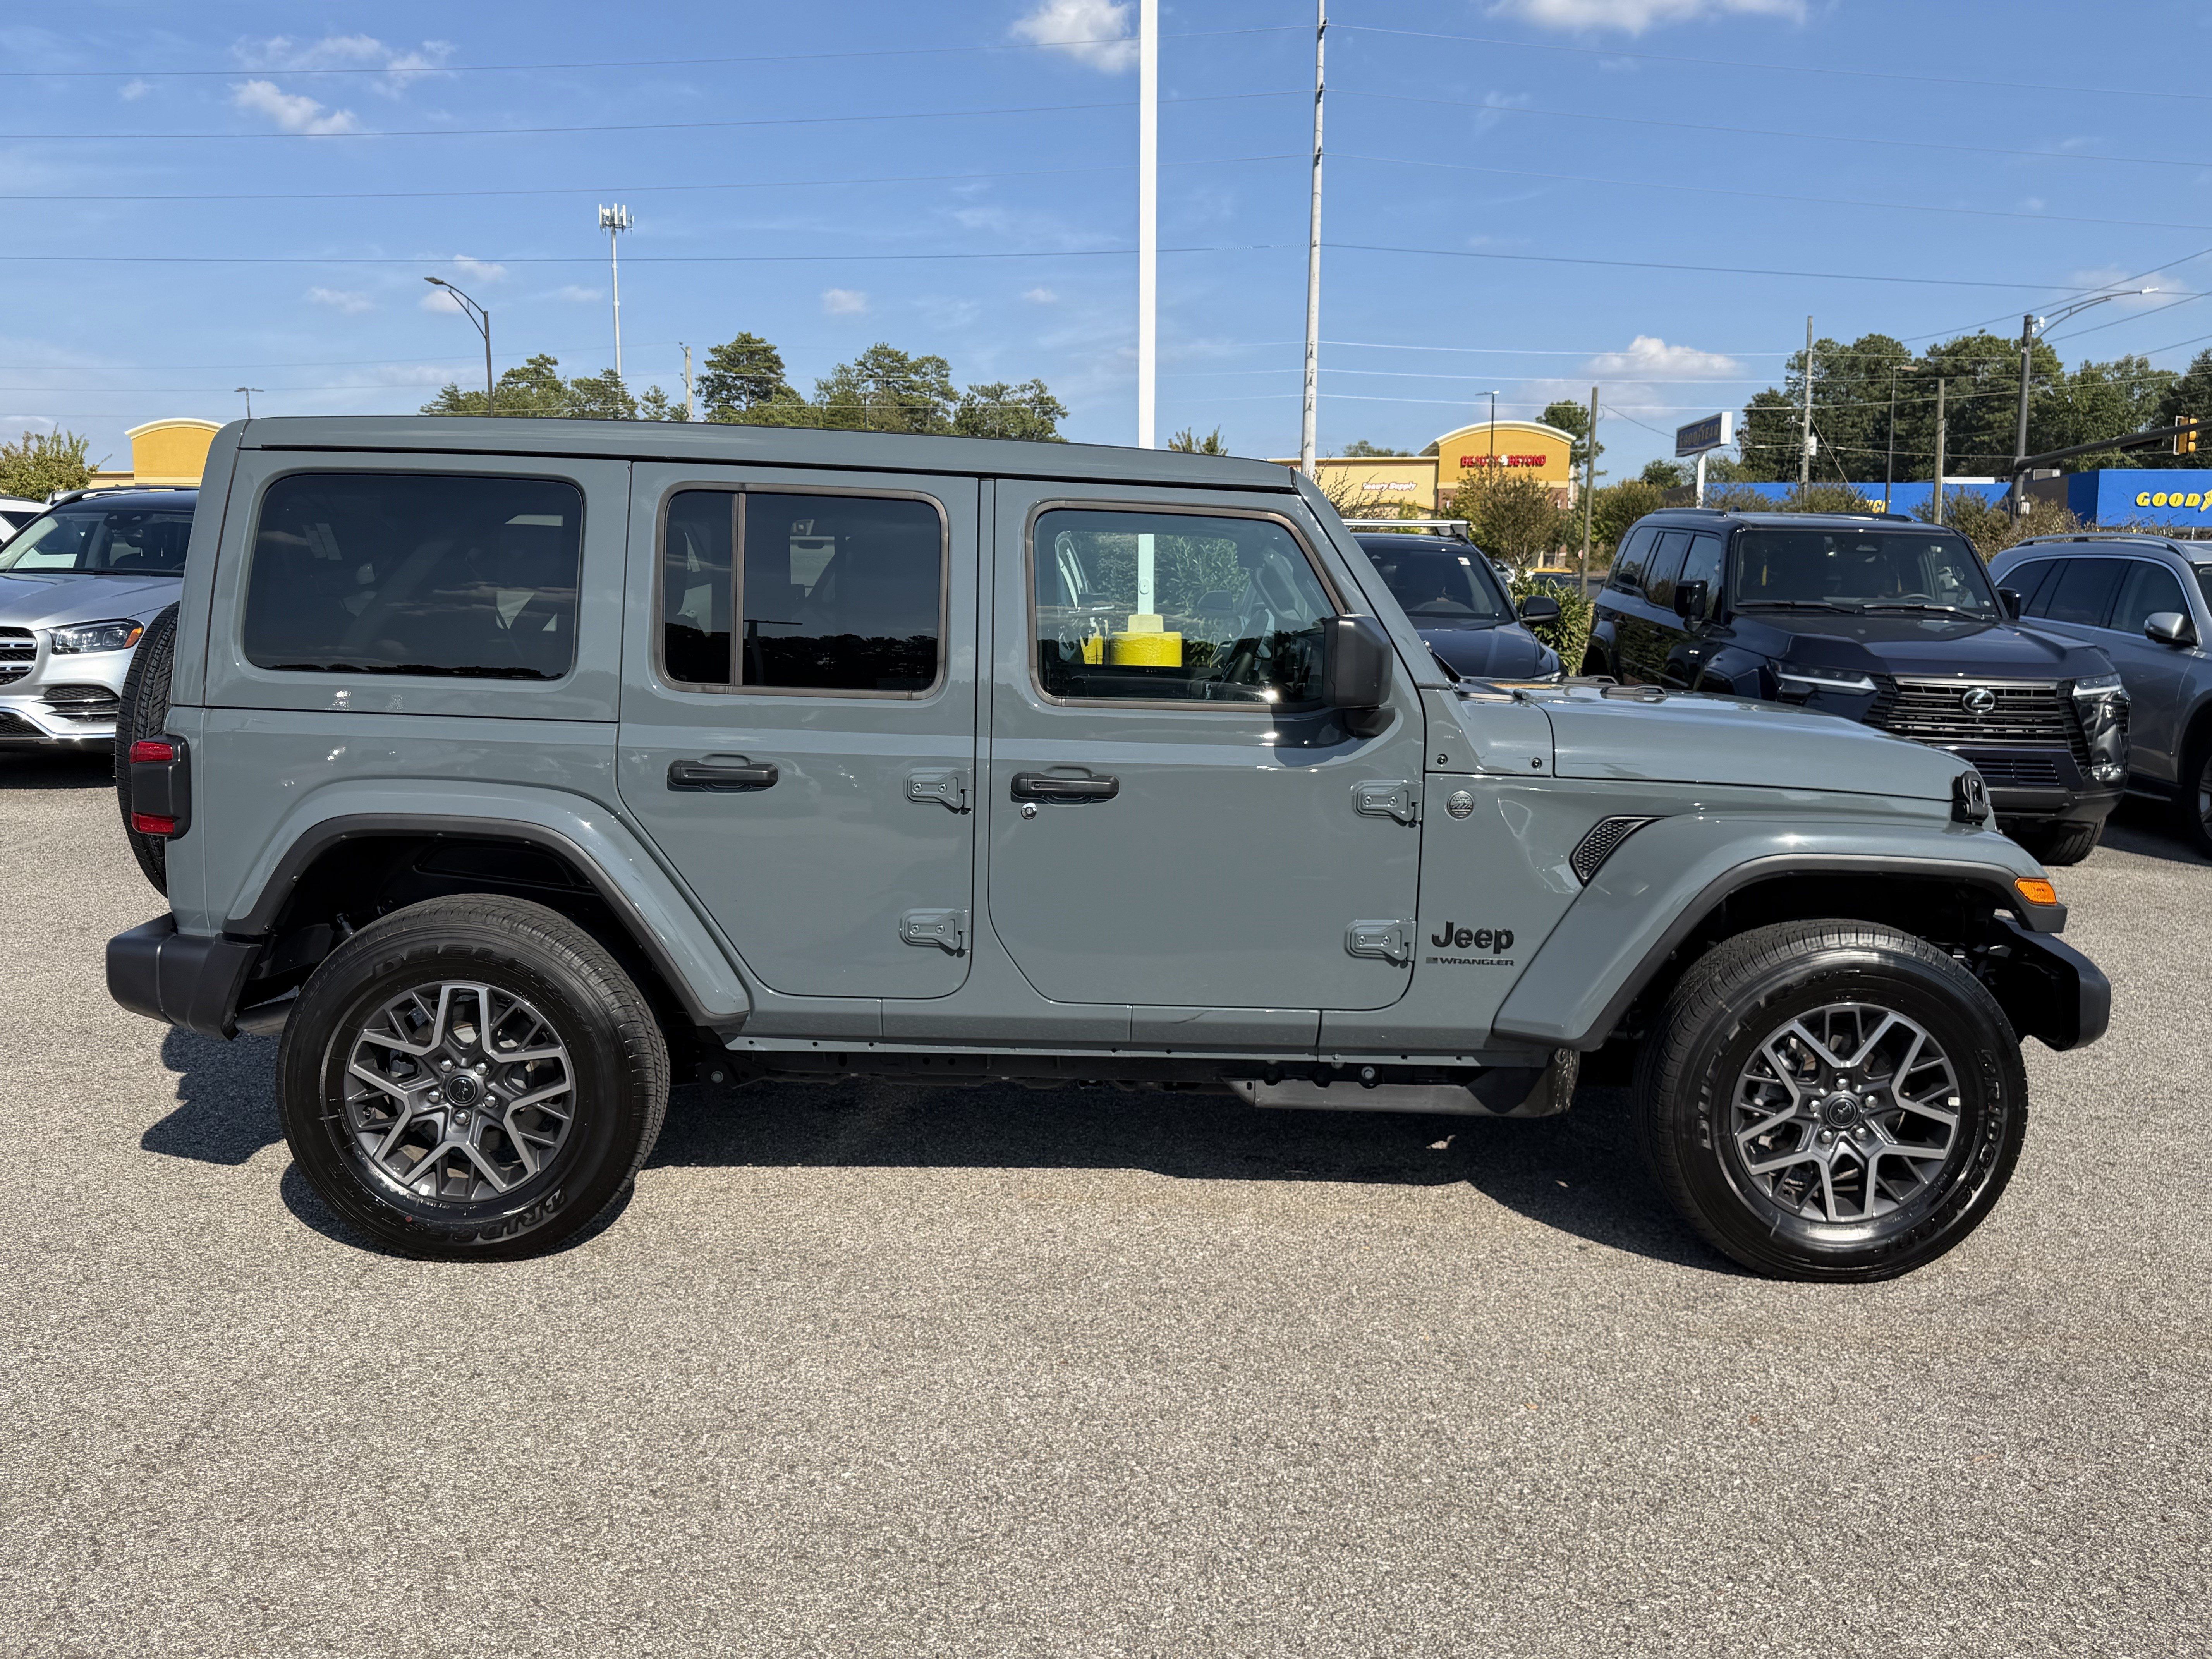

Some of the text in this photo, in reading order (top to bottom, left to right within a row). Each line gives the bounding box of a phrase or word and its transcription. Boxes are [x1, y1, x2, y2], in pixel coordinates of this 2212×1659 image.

[1509, 455, 1546, 467] BEYOND
[1388, 481, 1417, 491] Supply
[1432, 921, 1514, 954] Jeep
[1439, 957, 1514, 966] WRANGLER
